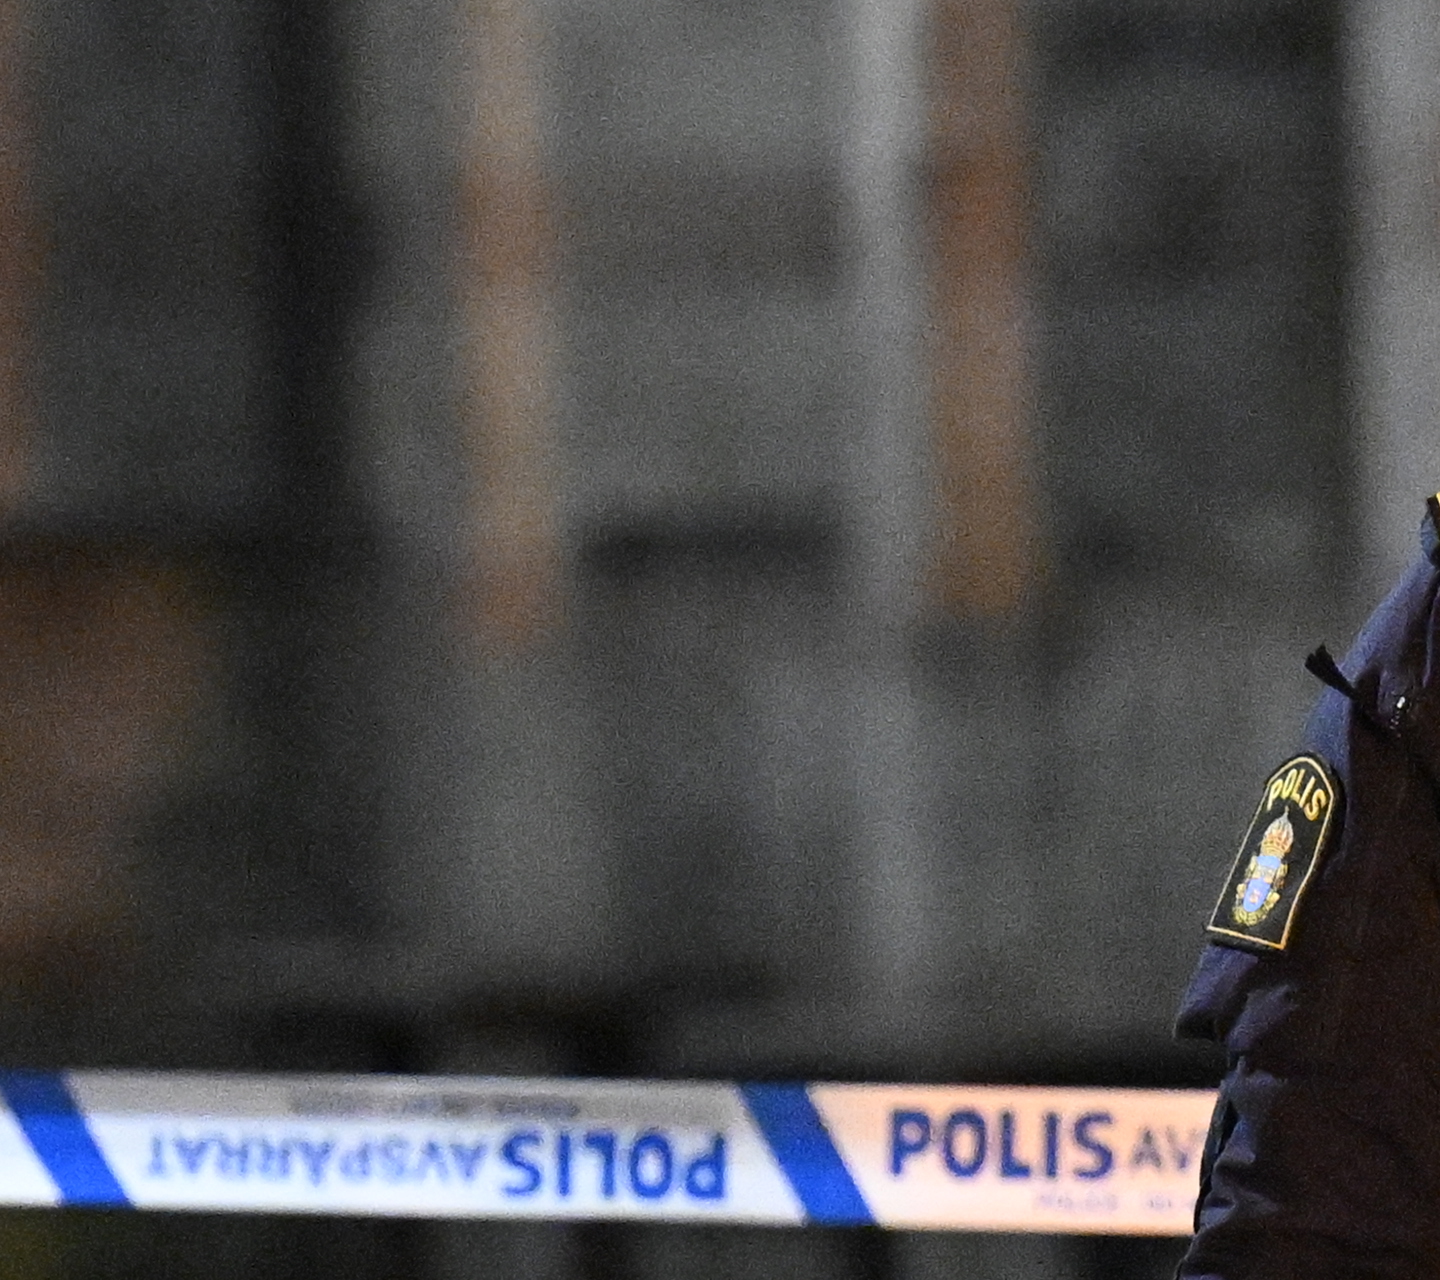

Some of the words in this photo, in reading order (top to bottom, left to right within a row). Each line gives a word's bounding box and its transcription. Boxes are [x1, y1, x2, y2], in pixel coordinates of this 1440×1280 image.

[1266, 768, 1327, 821] POLIS
[499, 1129, 729, 1202] POLIS
[889, 1108, 1115, 1180] POLIS
